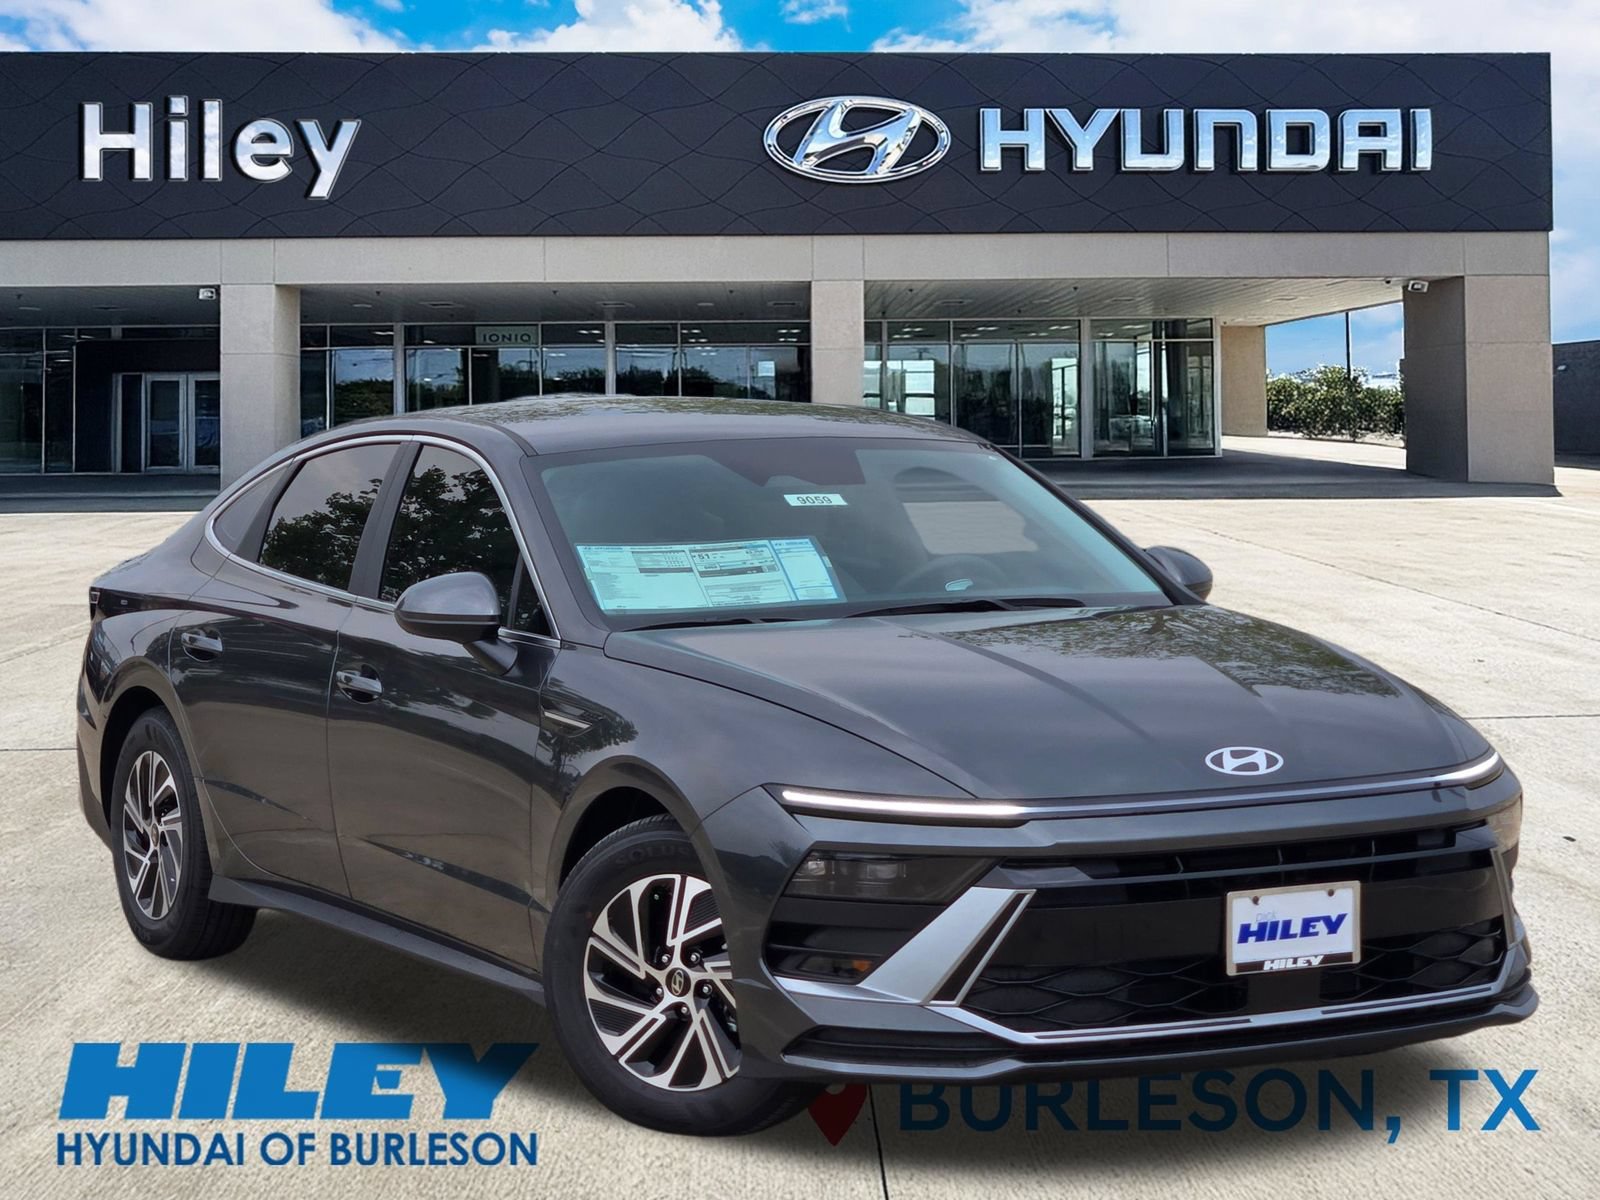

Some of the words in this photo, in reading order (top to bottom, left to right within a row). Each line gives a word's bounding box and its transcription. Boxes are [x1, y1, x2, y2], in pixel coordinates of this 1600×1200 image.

[81, 95, 361, 200] Hiley
[979, 107, 1432, 172] HYUNDAI
[797, 496, 833, 504] 9059
[1237, 913, 1348, 944] HILEY
[1263, 955, 1325, 971] HILEY
